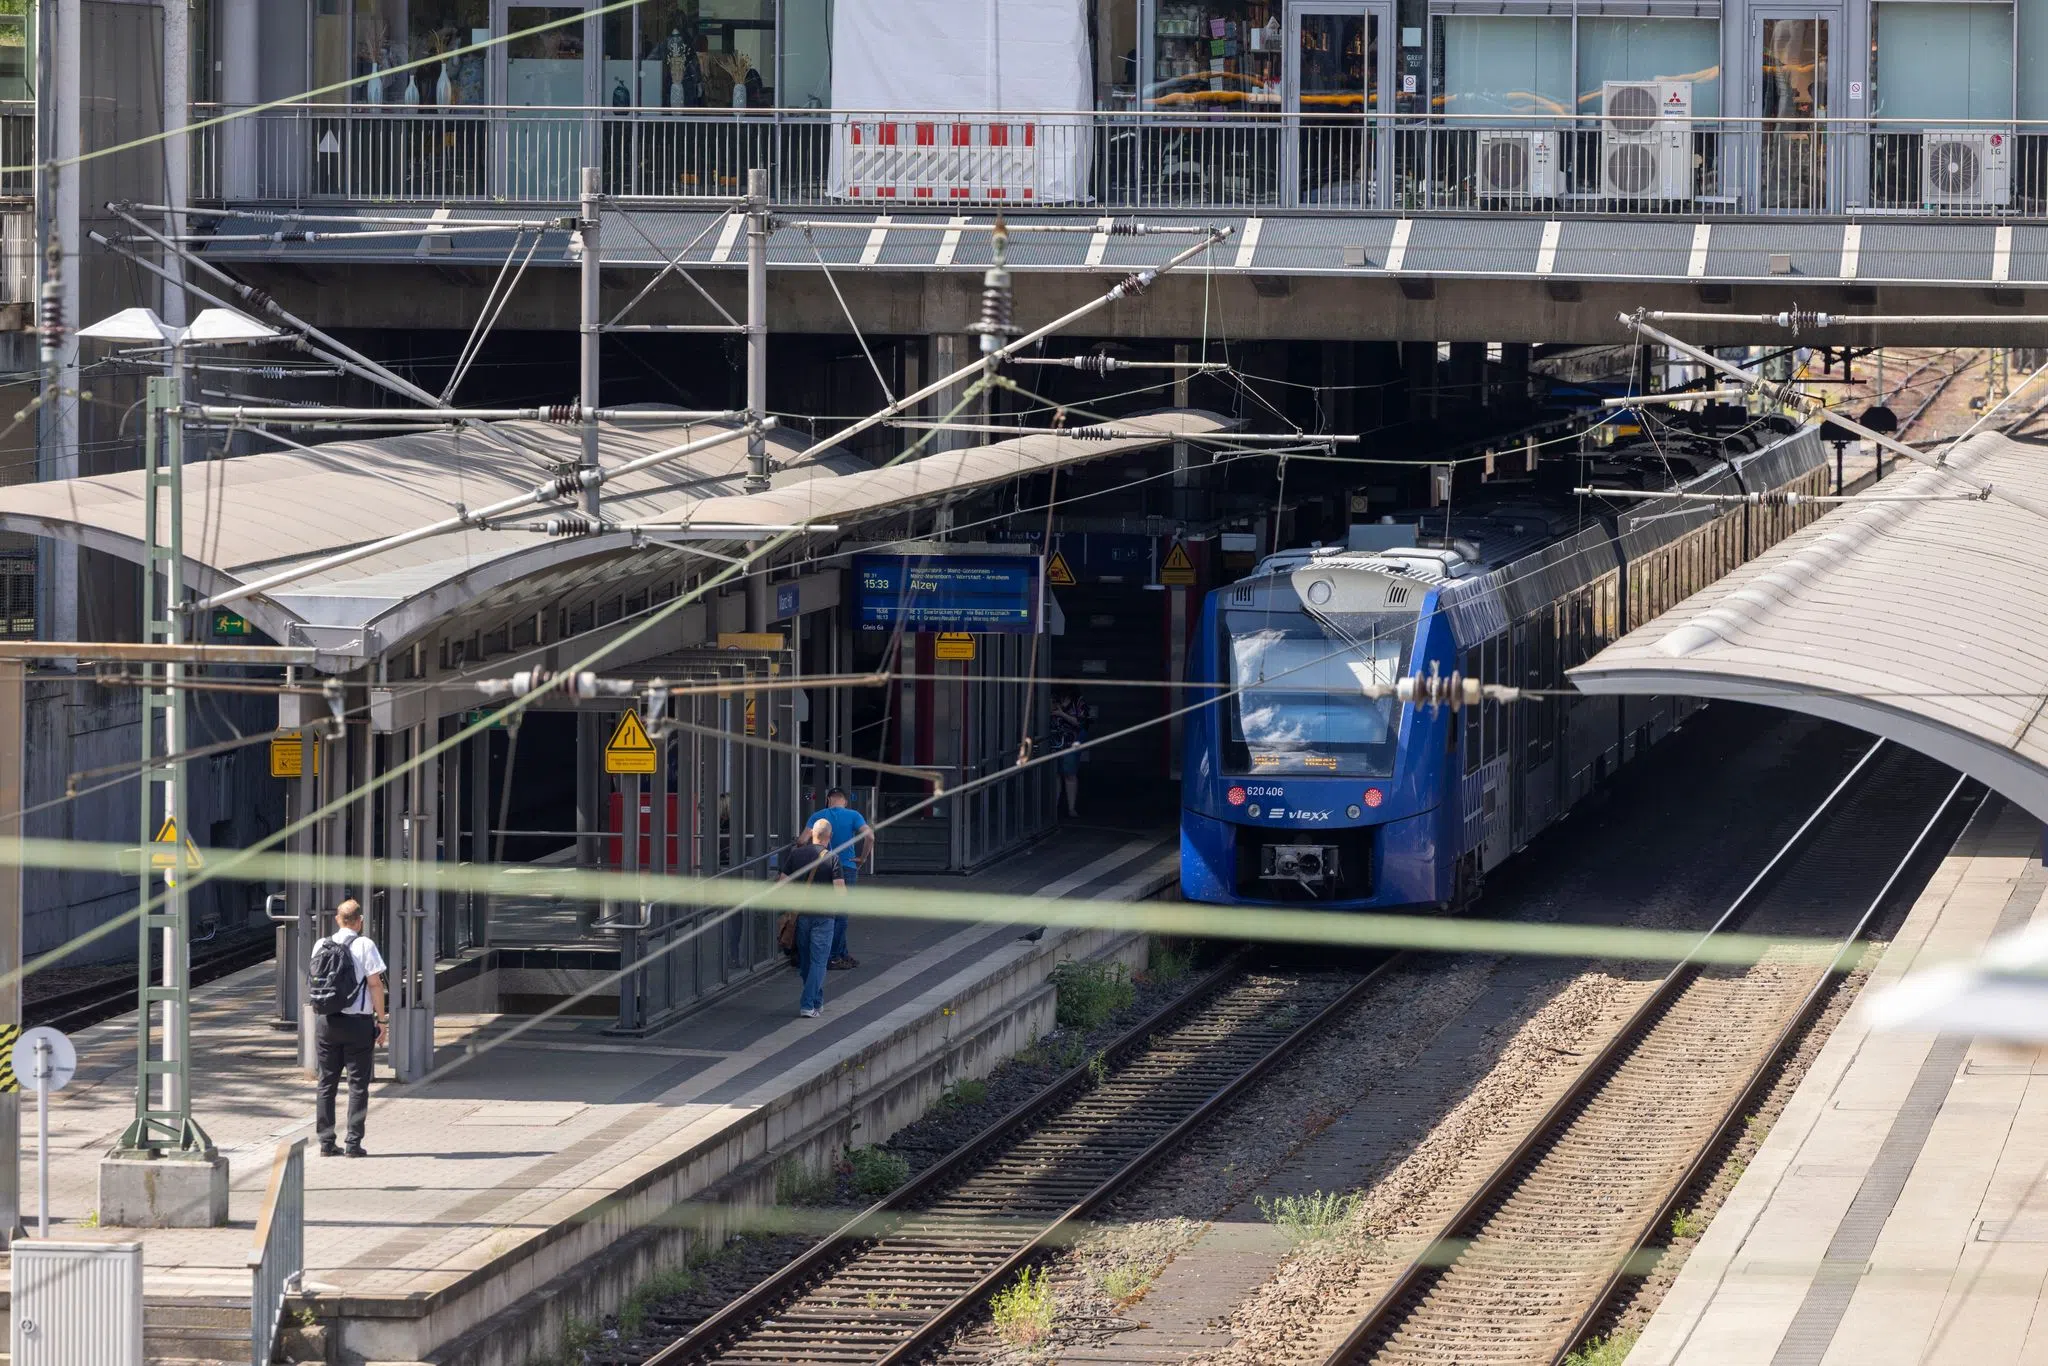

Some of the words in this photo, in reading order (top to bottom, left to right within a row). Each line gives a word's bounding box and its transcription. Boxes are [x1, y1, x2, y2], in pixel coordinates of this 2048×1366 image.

[864, 579, 889, 589] 15:33
[910, 580, 938, 592] Alzey
[1246, 786, 1264, 796] 620
[1265, 787, 1284, 797] 406
[1288, 808, 1335, 822] vlexx
